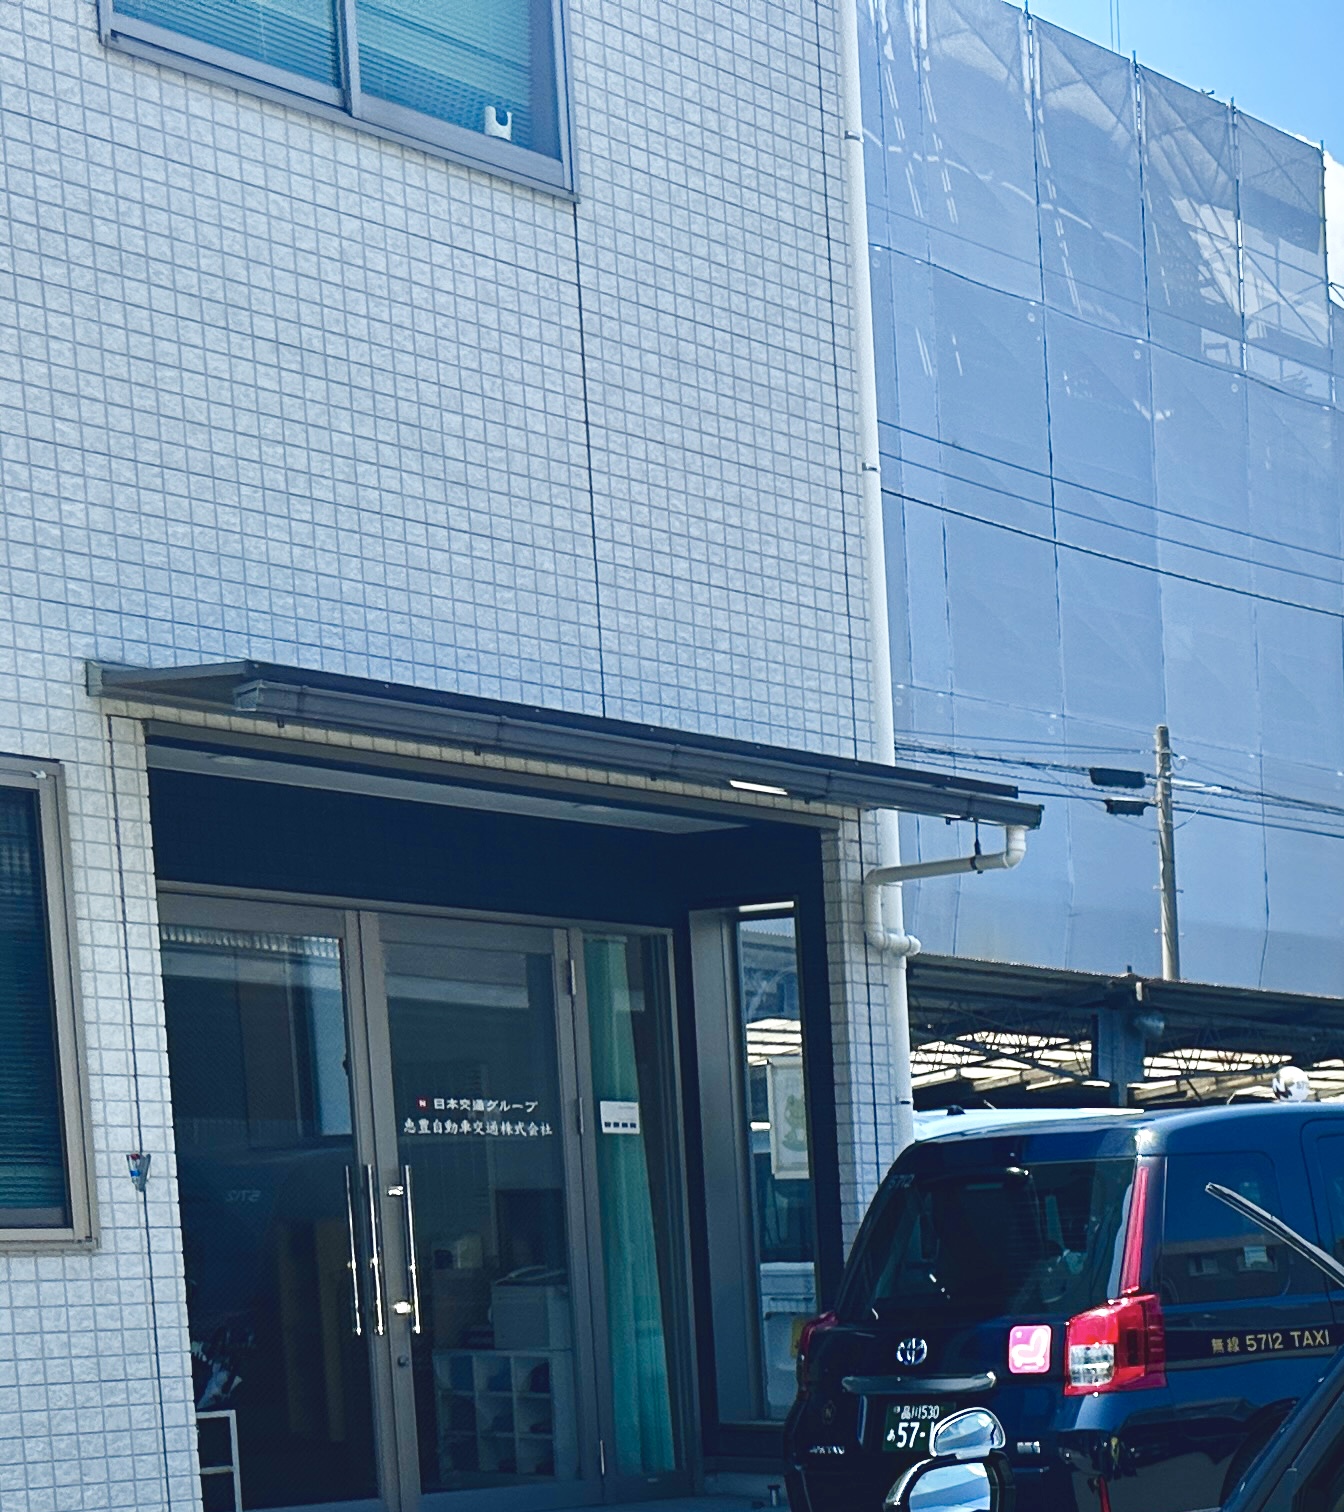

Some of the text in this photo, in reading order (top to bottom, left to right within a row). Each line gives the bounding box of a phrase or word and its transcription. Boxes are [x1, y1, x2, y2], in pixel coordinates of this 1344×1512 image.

[433, 1098, 538, 1113] 日本交通グループ
[1211, 1329, 1330, 1354] 無線 5712 TAXI
